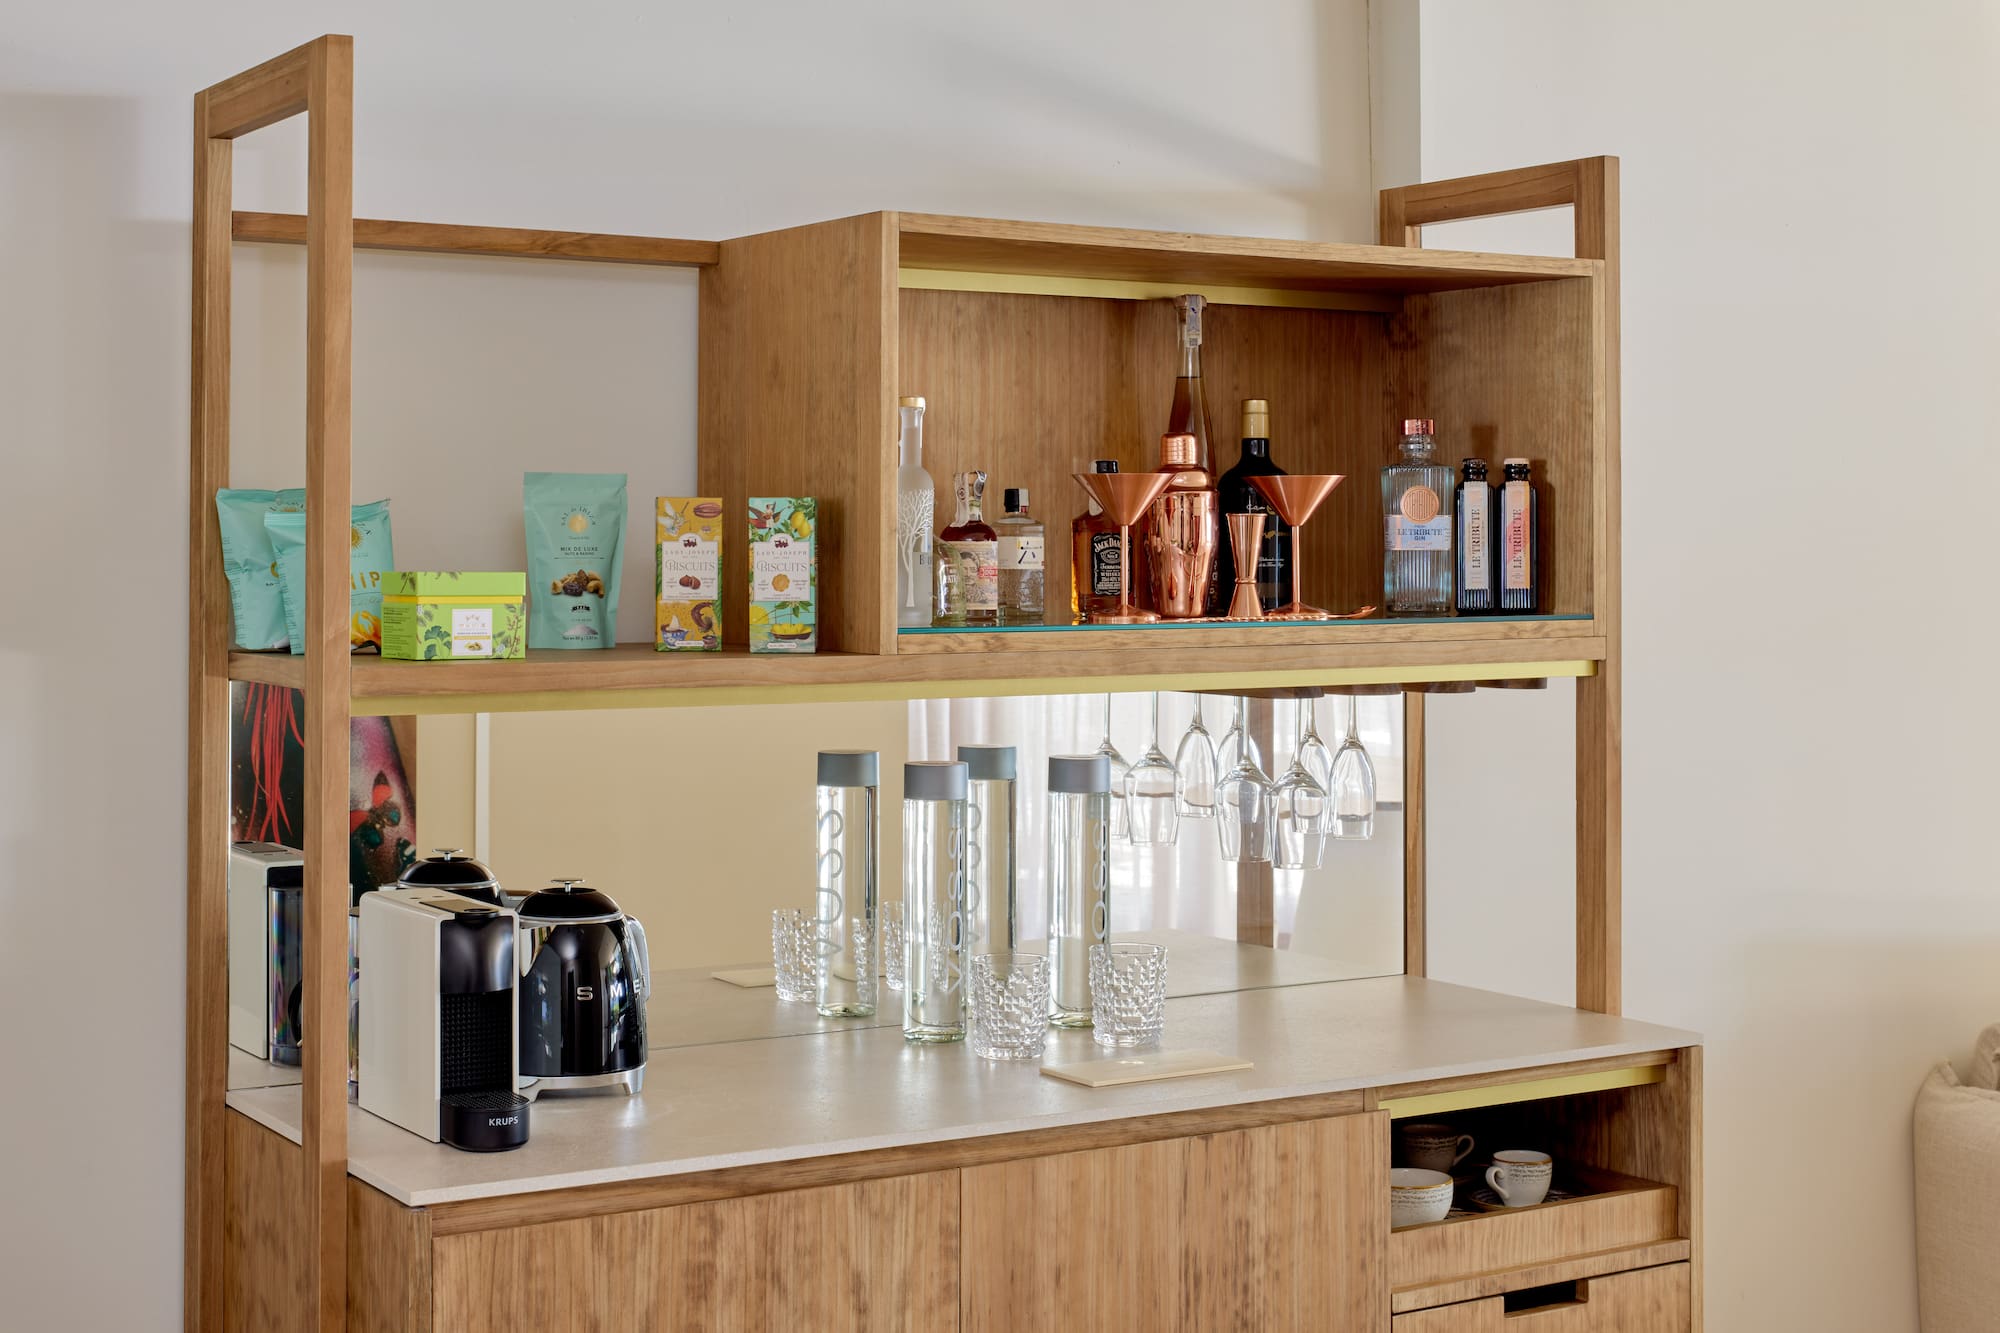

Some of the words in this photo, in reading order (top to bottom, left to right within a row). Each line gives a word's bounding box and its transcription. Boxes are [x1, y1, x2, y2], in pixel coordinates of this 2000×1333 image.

[1471, 508, 1481, 555] TRIBUTE
[1512, 508, 1522, 555] TRIBUTE
[1094, 540, 1109, 553] JACK
[665, 560, 716, 572] BISCUITS
[756, 560, 808, 572] BISCUITS
[1471, 556, 1481, 569] LE
[1512, 556, 1522, 569] LE
[1091, 820, 1107, 940] OSS
[488, 1115, 519, 1127] KRUPS
